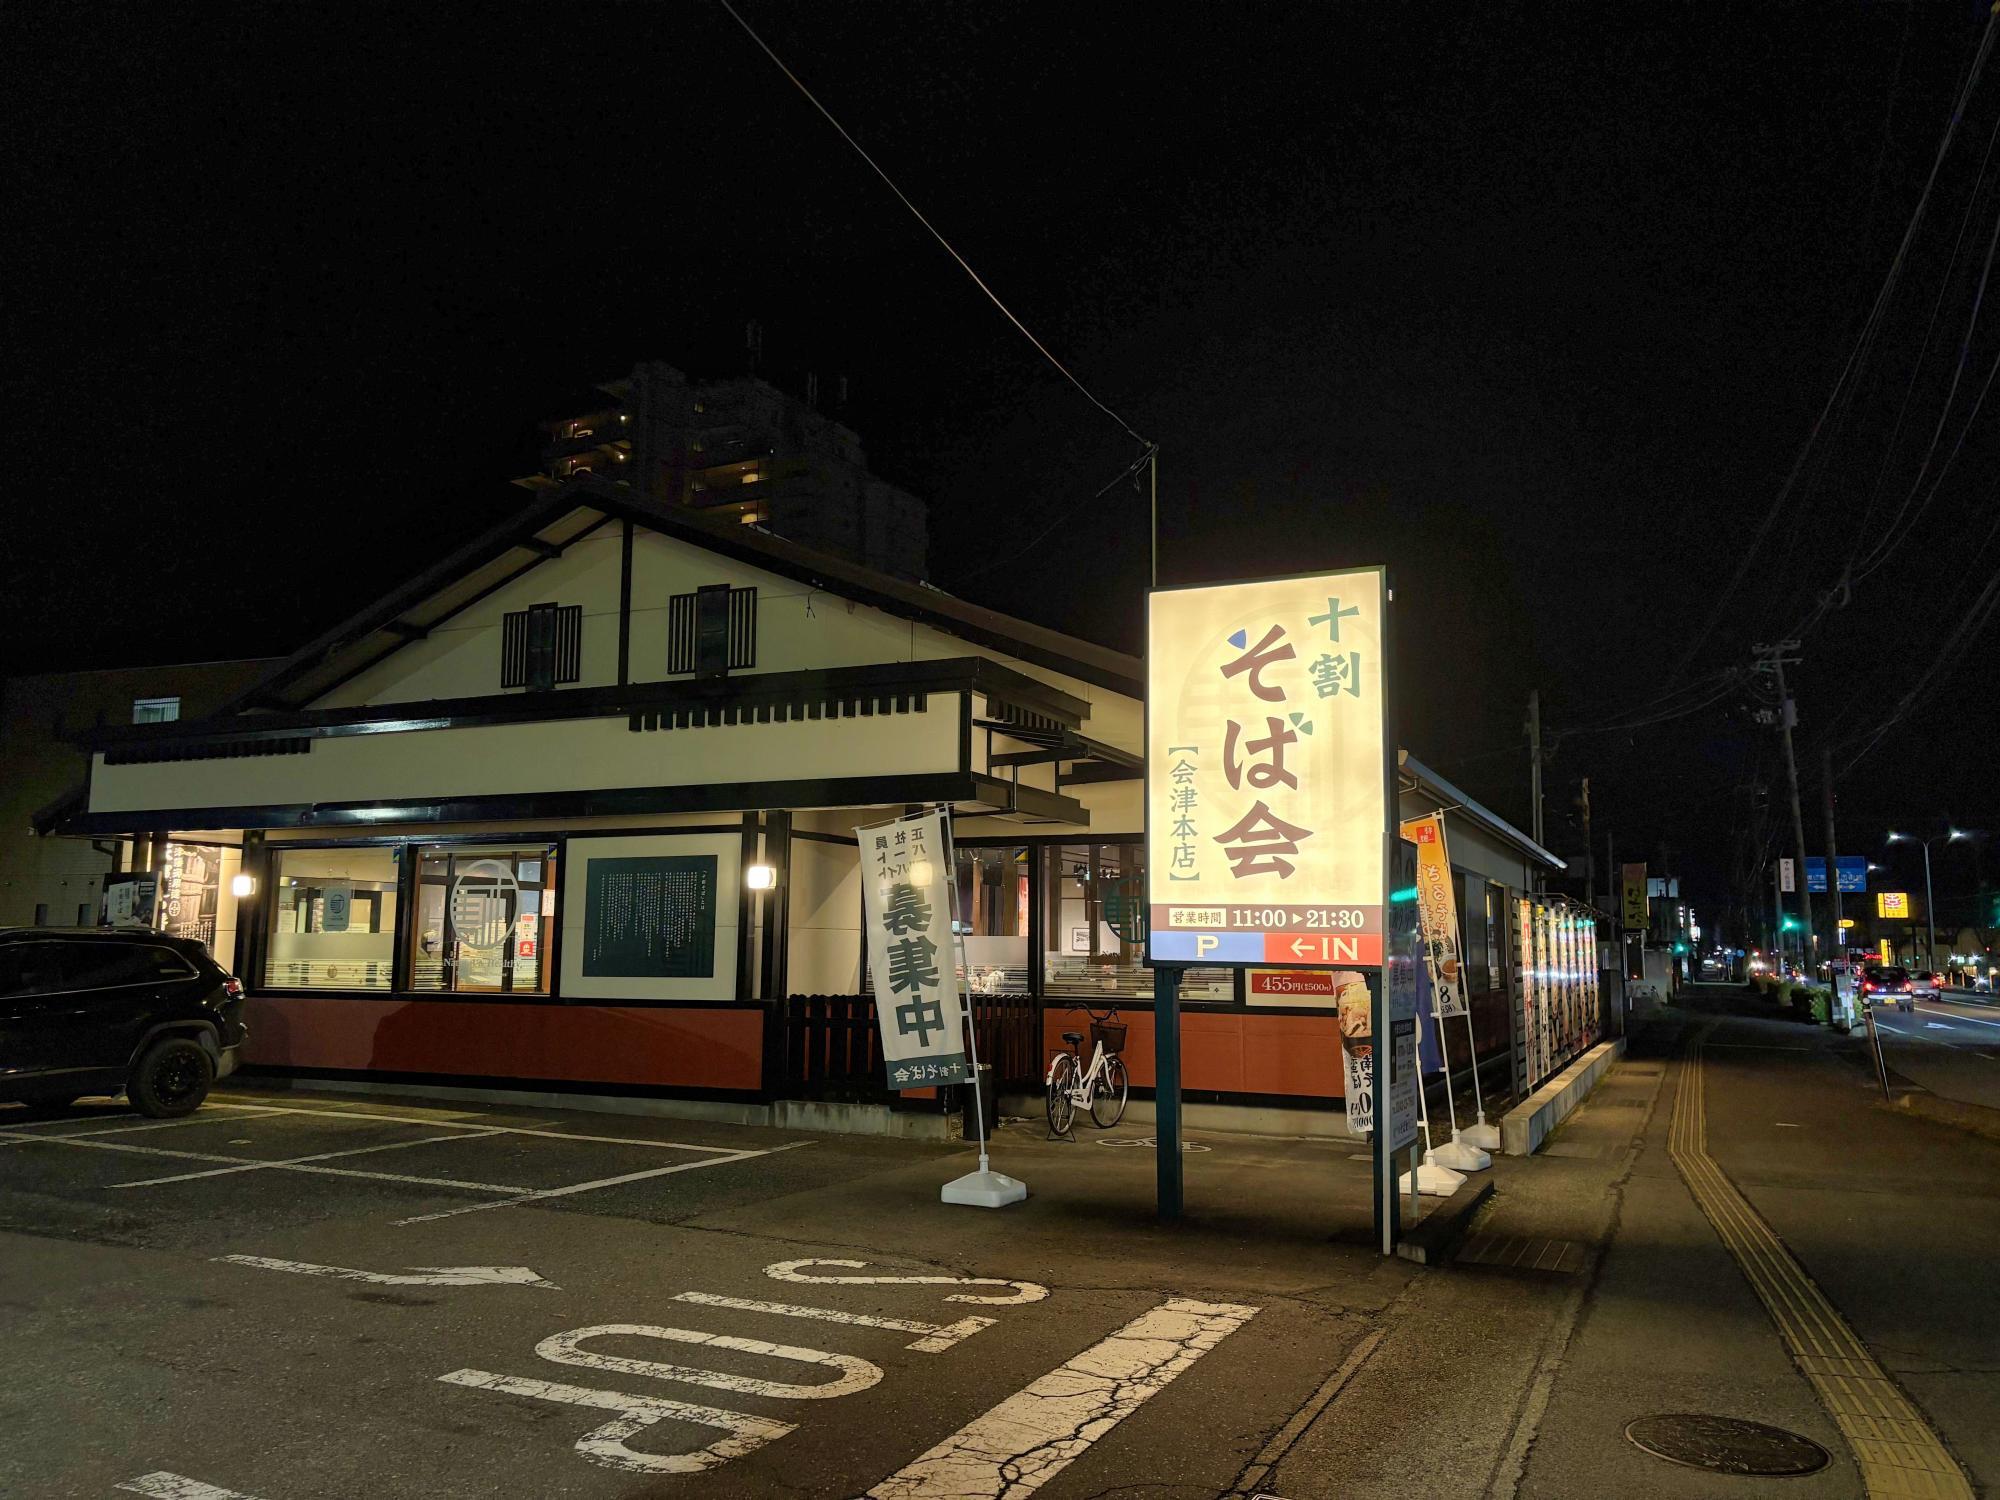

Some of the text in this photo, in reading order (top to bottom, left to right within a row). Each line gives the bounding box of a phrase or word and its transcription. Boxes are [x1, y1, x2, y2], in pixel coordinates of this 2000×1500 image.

[1308, 596, 1361, 699] 十割
[1212, 623, 1315, 880] そば会
[1171, 909, 1363, 930] 営業時間 11:00 21:30
[1196, 936, 1219, 957] P
[1323, 938, 1359, 960] IN
[437, 1258, 1052, 1474] STOP
